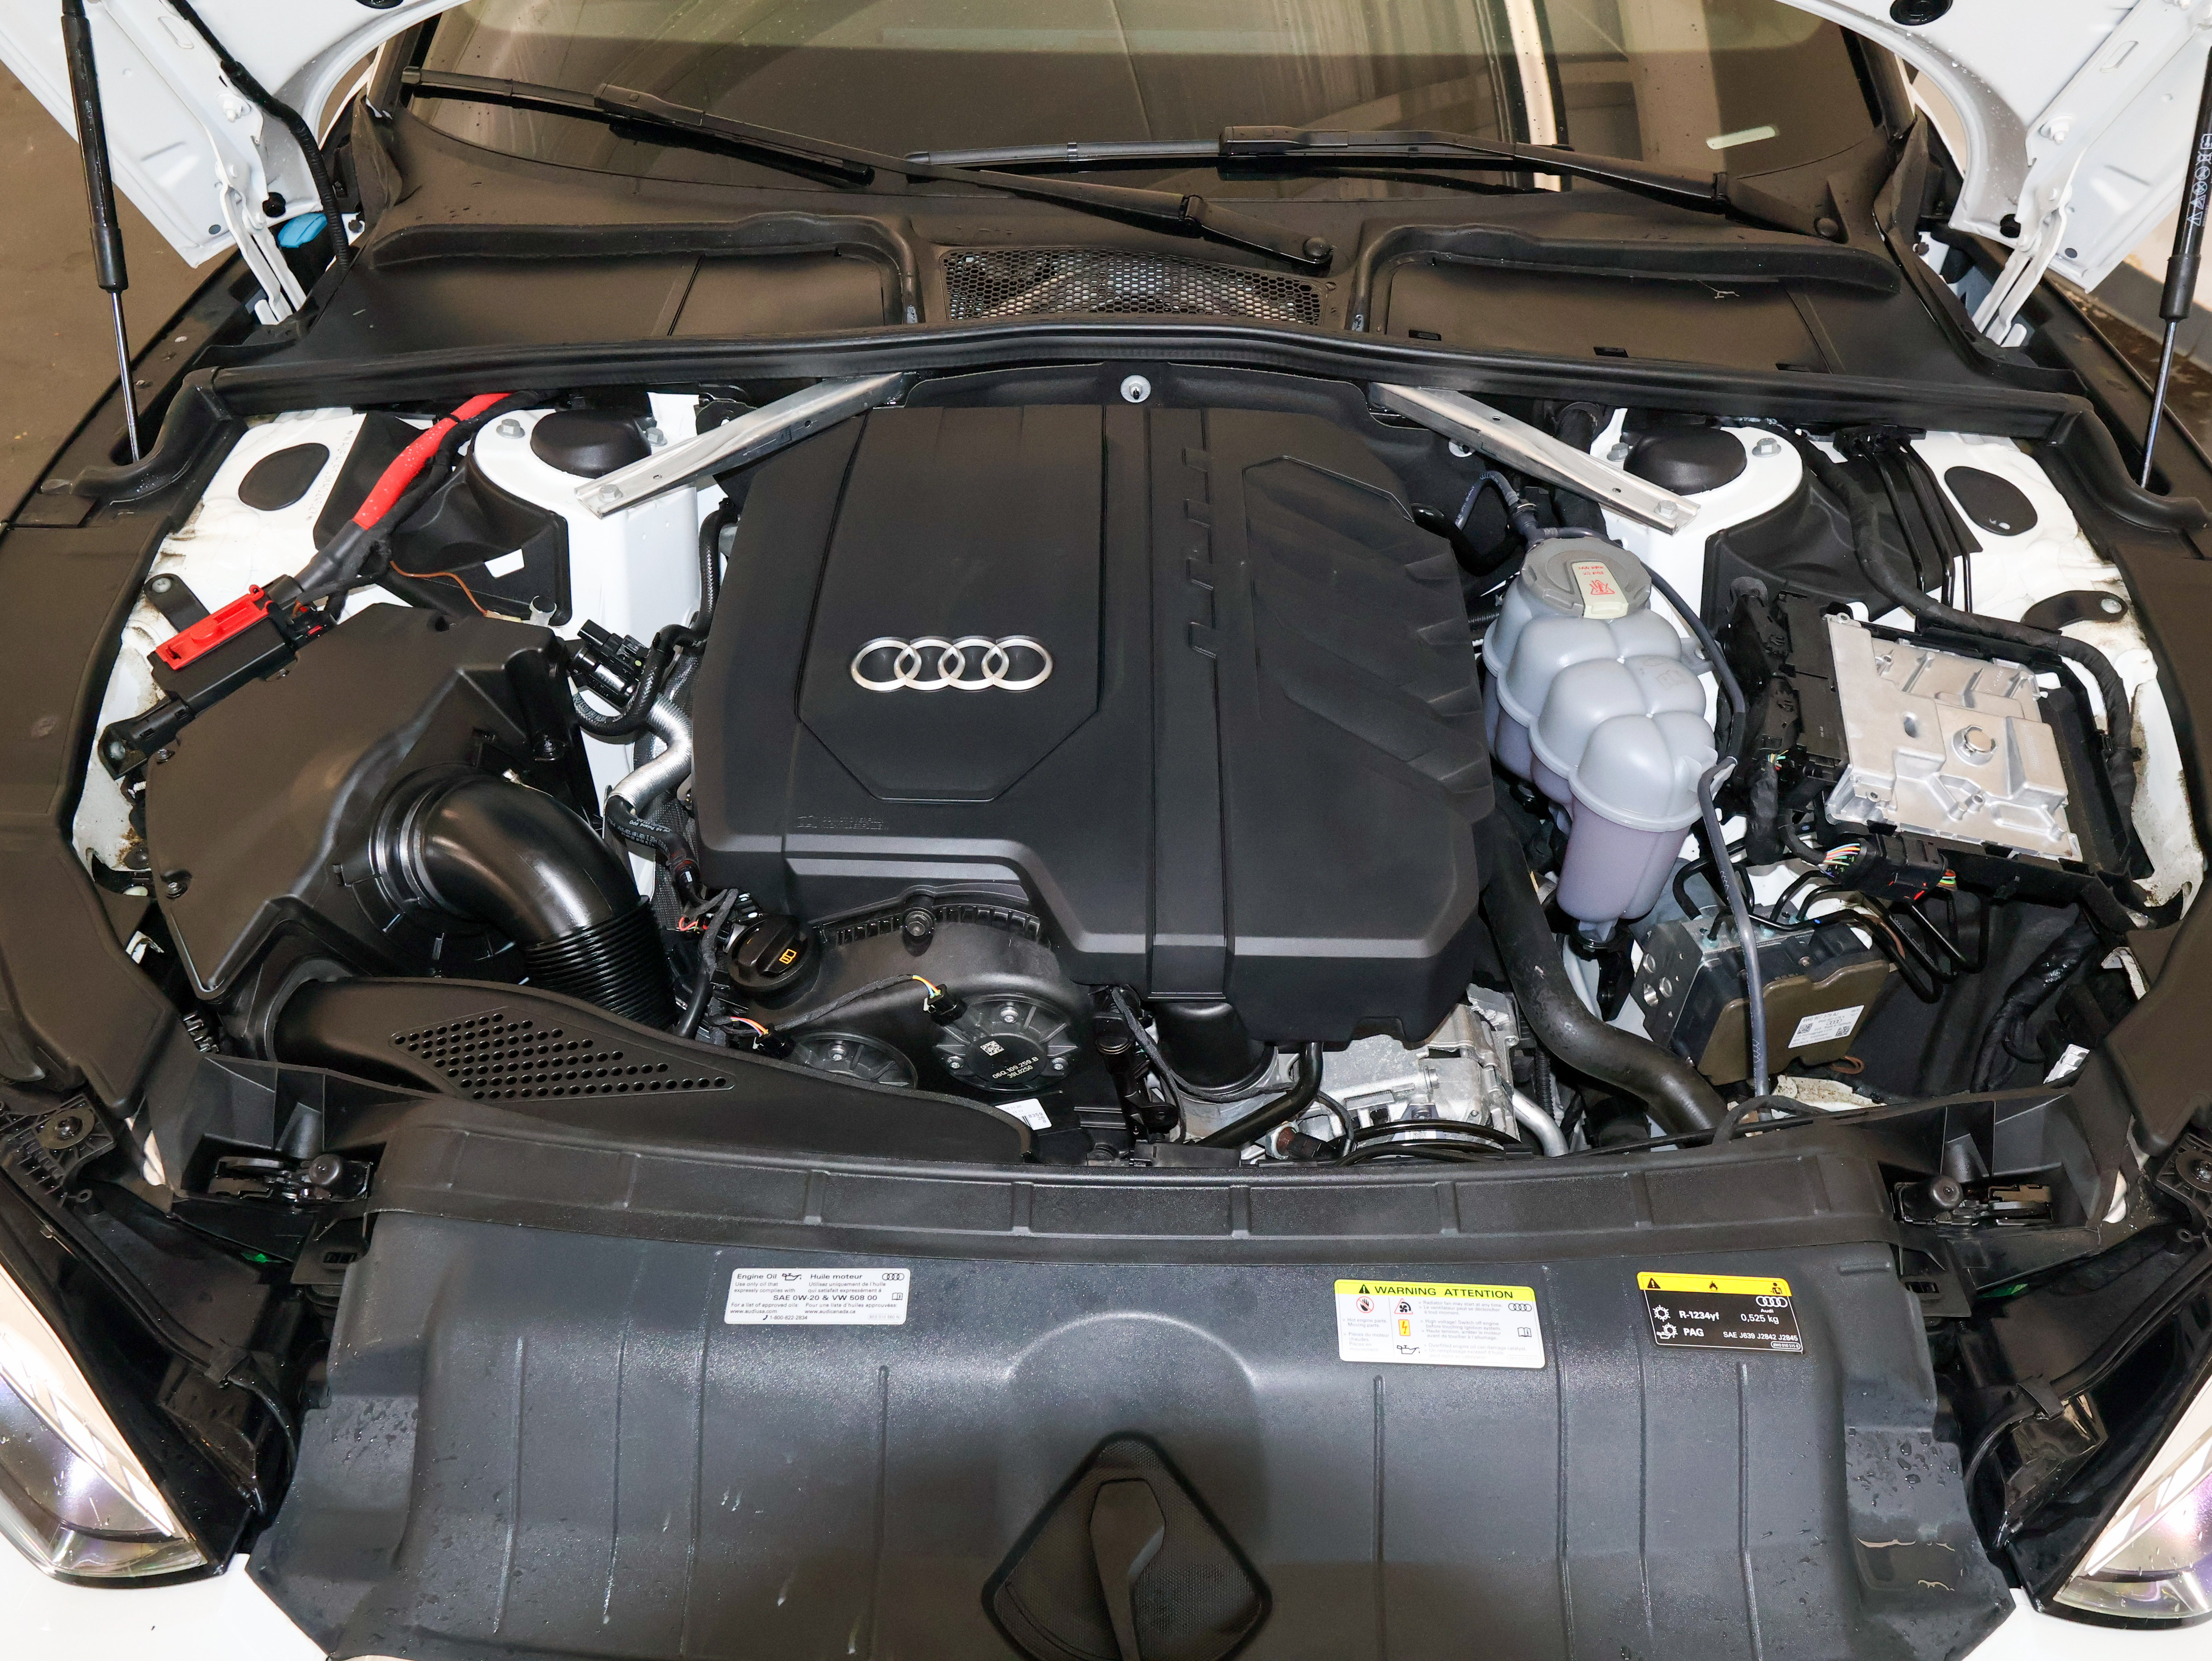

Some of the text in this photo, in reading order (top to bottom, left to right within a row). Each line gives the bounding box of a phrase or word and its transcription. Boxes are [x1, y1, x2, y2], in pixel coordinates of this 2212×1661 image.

[1375, 1286, 1513, 1298] WARNING ATTENTION
[1679, 1311, 1720, 1321] R-1234yf
[1740, 1313, 1779, 1325] 0,525 kg
[1683, 1328, 1704, 1336] PAG
